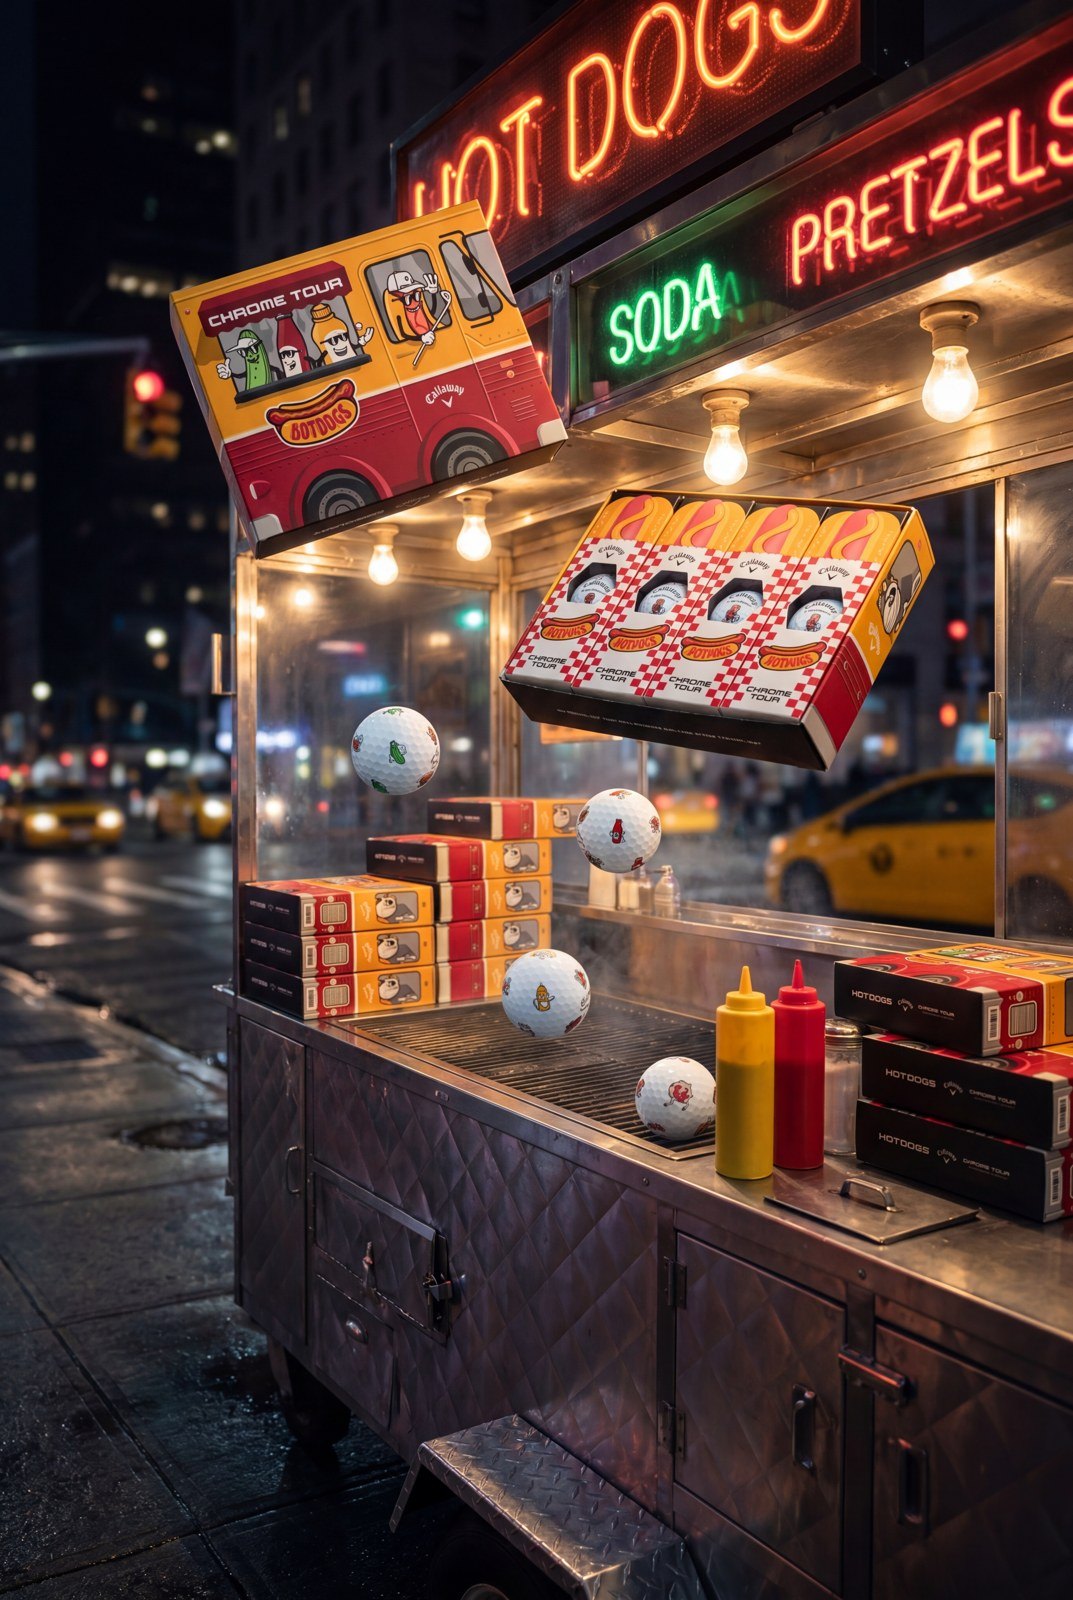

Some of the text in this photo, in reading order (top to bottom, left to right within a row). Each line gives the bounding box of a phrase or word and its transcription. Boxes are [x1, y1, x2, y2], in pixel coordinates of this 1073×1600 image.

[208, 277, 344, 328] CHROME TOUR
[609, 263, 721, 365] SODA
[425, 384, 465, 405] Callaway
[528, 655, 567, 664] CHROME
[595, 667, 637, 677] CHROME
[600, 674, 626, 682] TOUR
[669, 676, 712, 687] CHROME
[674, 684, 702, 693] TOUR
[746, 686, 792, 697] CHROME
[751, 694, 781, 703] TOUR
[851, 989, 893, 1005] HOTDOGS
[885, 1068, 936, 1088] HOTDOGS
[879, 1132, 930, 1155] HOTDOGS
